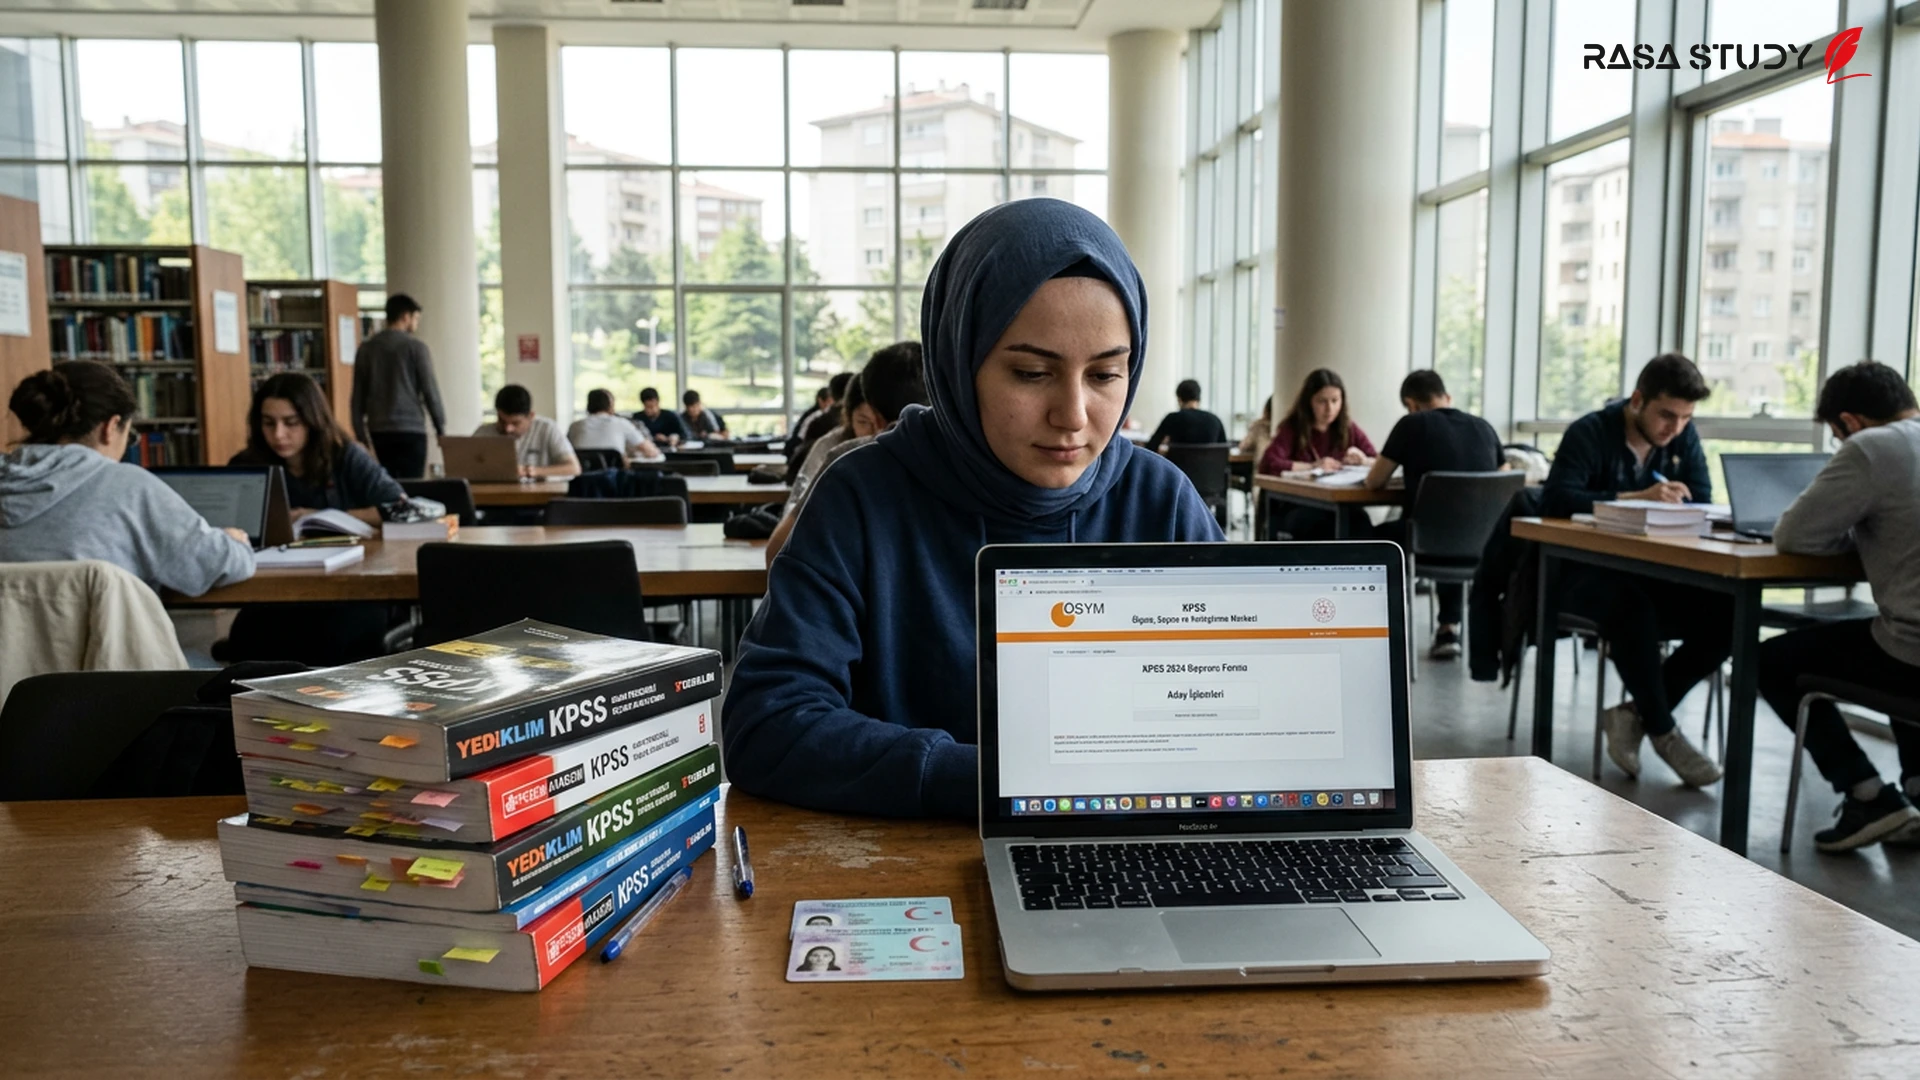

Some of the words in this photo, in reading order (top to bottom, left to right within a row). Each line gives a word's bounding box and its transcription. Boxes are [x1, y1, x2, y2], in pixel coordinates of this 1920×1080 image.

[1063, 602, 1105, 615] OSYM
[549, 695, 608, 738] KPSS
[590, 745, 629, 780] KPSS
[586, 799, 635, 846] KPSS
[617, 865, 649, 909] KPSS
